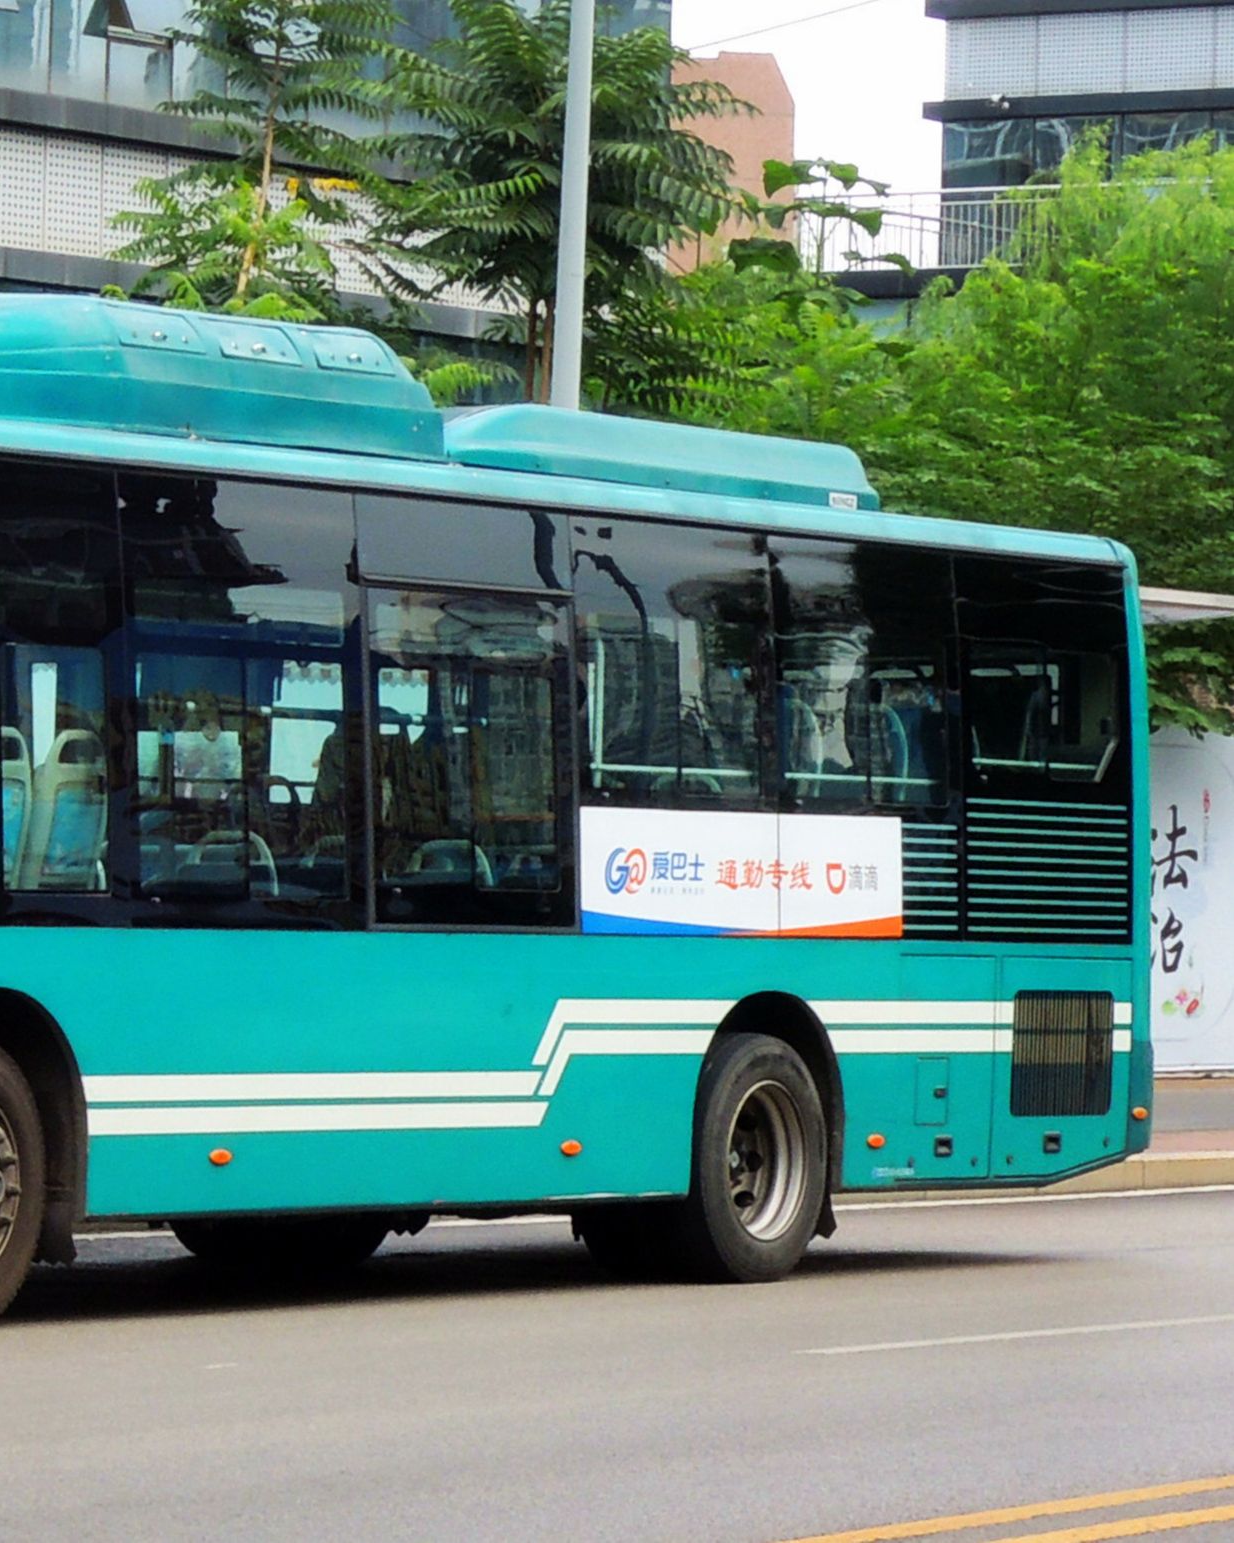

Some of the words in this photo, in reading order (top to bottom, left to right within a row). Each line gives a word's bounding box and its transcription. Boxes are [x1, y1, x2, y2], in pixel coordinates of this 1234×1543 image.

[650, 851, 706, 881] 爱巴士
[714, 859, 814, 890] 通勤专线
